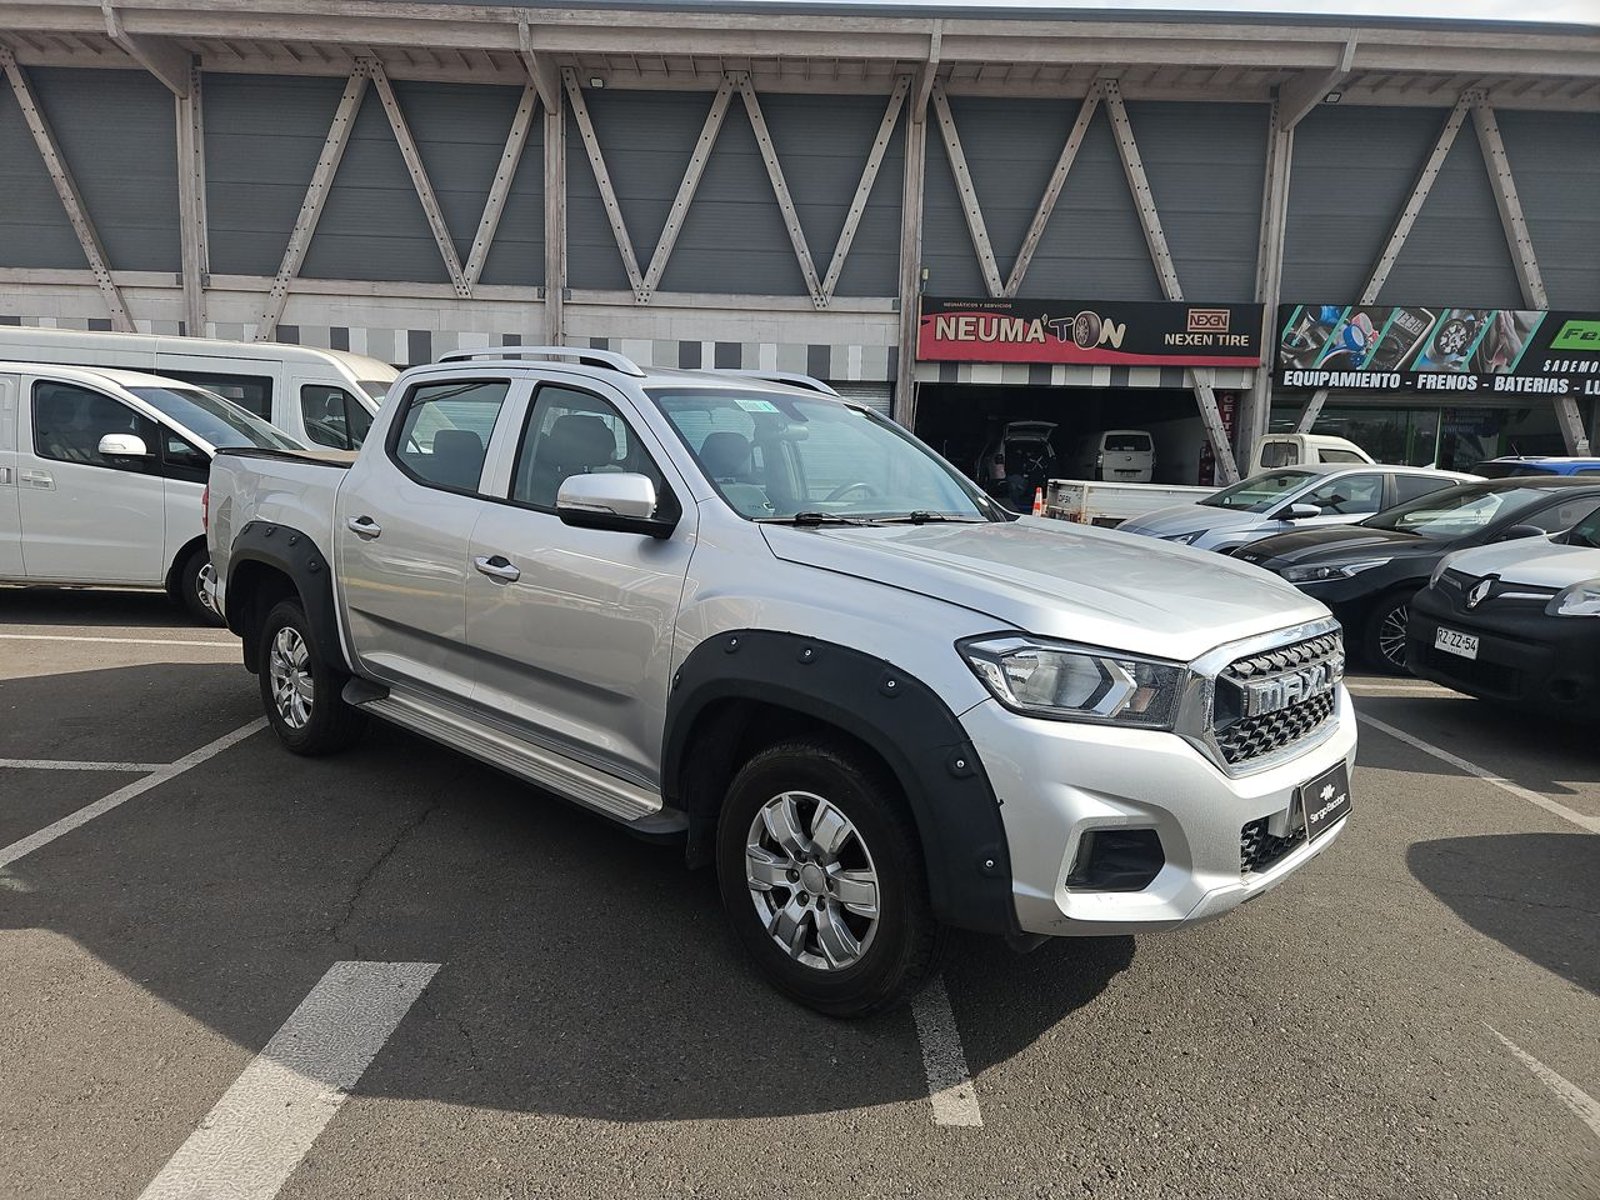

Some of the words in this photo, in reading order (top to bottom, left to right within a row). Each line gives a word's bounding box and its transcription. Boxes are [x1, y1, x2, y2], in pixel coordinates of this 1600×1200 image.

[1189, 314, 1228, 327] NEXEN
[1164, 333, 1213, 346] NEXEN
[1217, 334, 1249, 347] TIRE
[1563, 328, 1600, 340] Fe
[1543, 359, 1600, 374] SABEMO
[1283, 370, 1401, 388] EQUIPAMIENTO
[1417, 374, 1478, 390] FRENOS
[1494, 377, 1569, 394] BATERIAS
